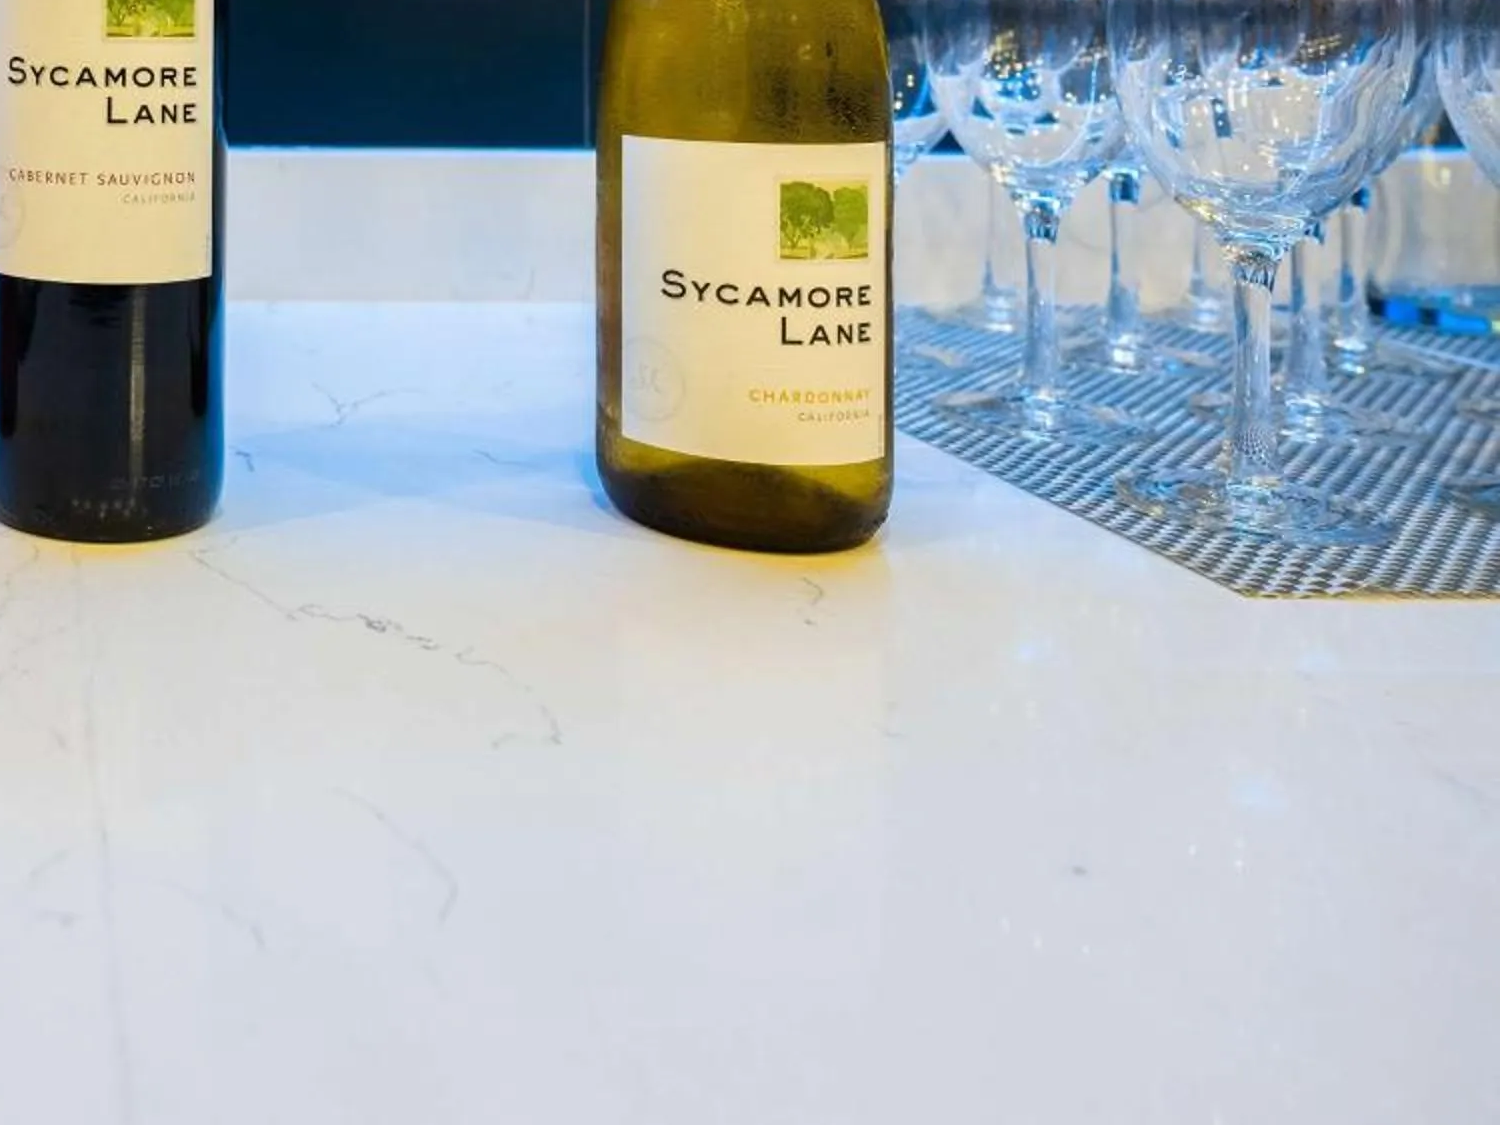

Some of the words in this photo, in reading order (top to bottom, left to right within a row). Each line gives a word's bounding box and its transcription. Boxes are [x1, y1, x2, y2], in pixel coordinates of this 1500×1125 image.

[8, 56, 197, 88] SYCAMORE
[106, 96, 197, 124] LANE
[9, 167, 88, 186] CABERNET
[96, 171, 196, 187] SAUVIGNON
[123, 191, 196, 205] CALIFORNIA
[661, 269, 872, 308] SYCAMORE
[781, 316, 872, 346] LANE
[749, 389, 871, 405] CHARDONNAY
